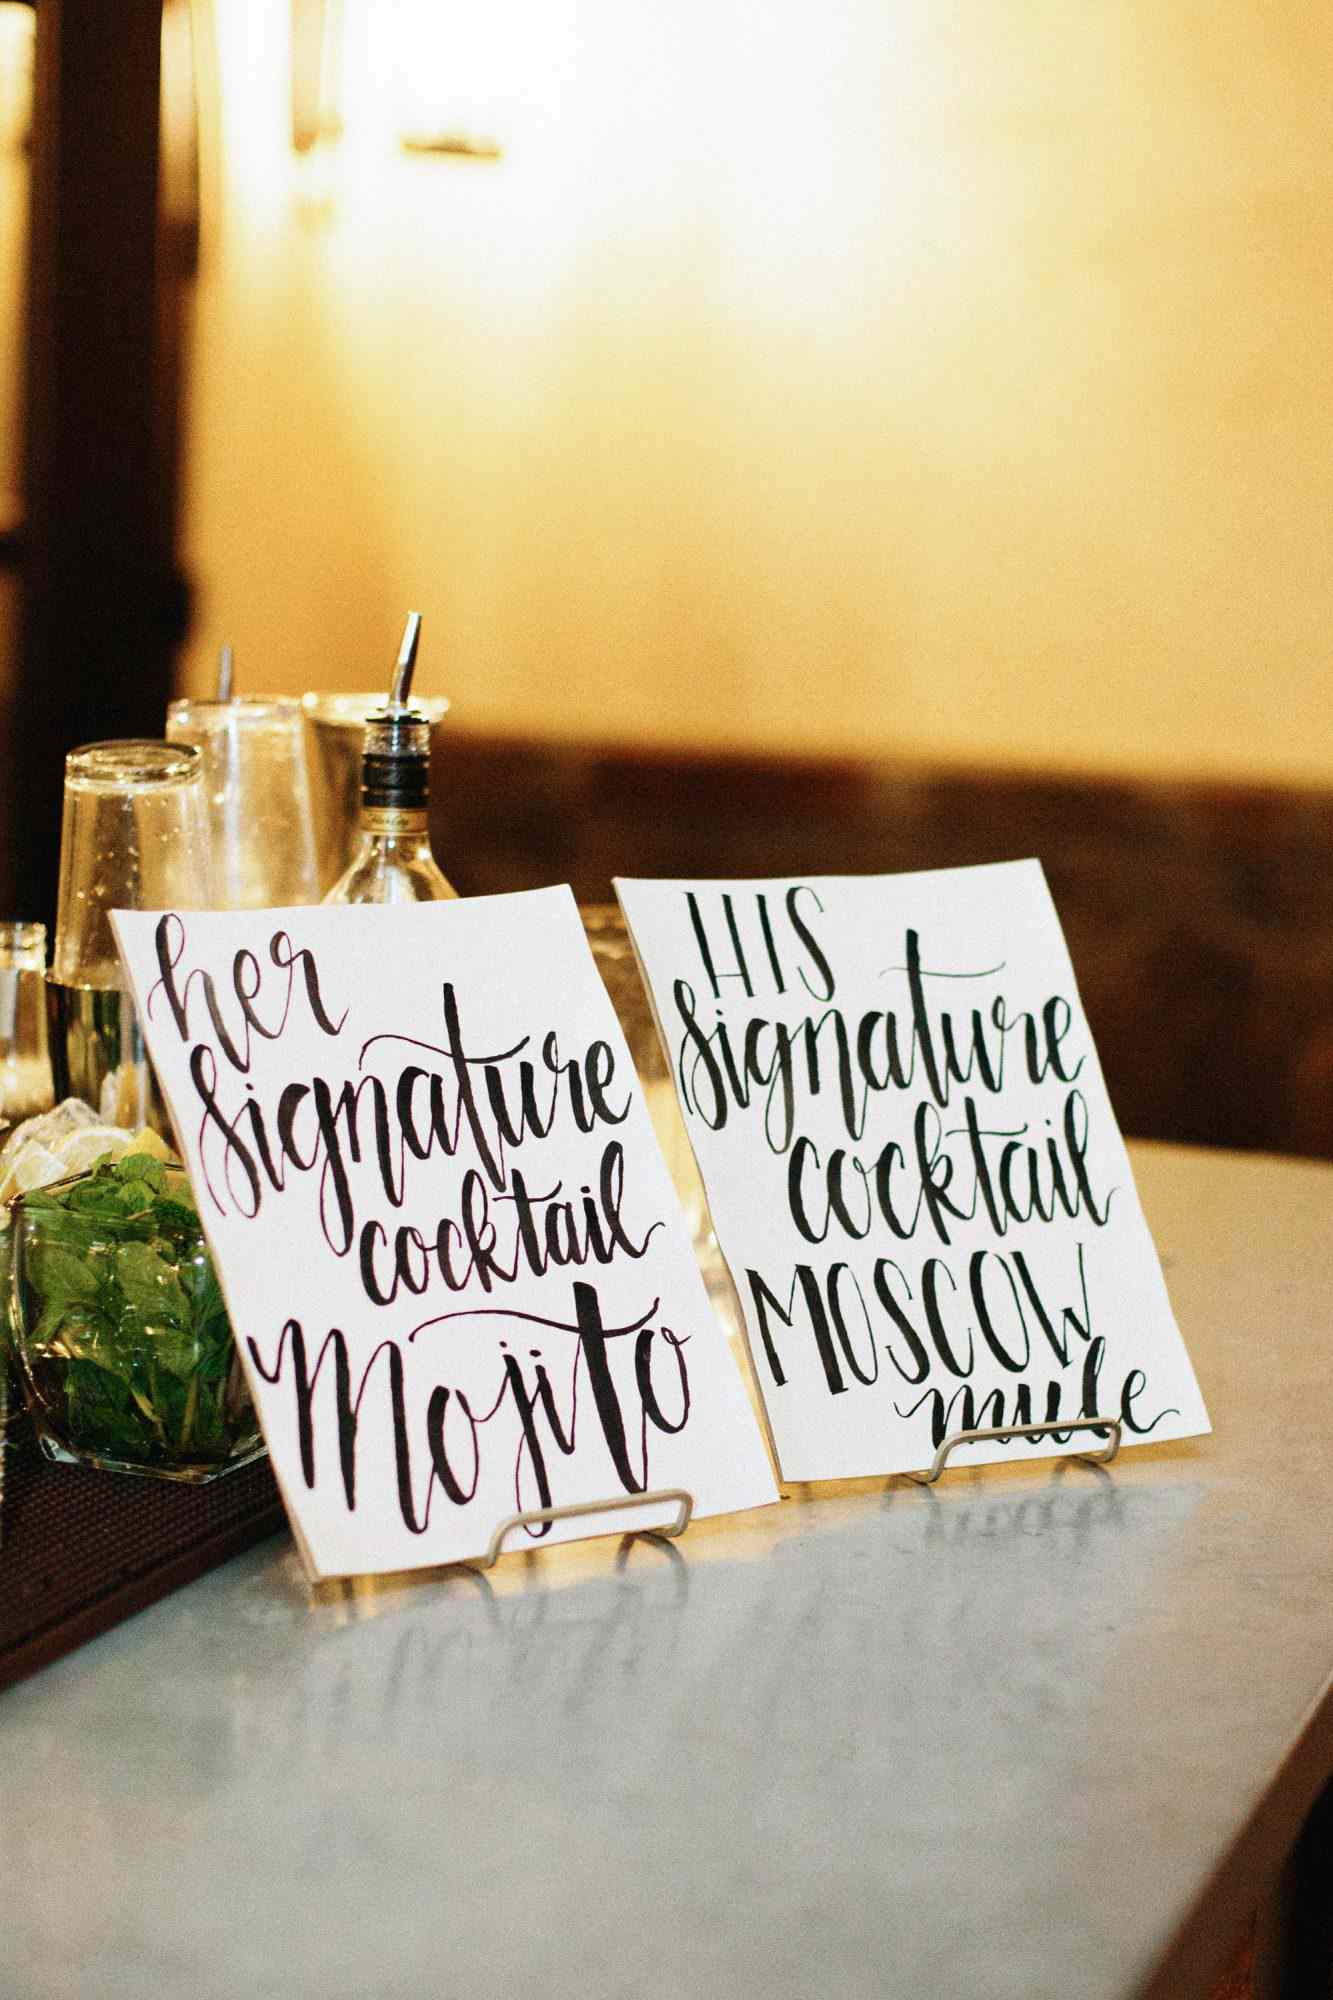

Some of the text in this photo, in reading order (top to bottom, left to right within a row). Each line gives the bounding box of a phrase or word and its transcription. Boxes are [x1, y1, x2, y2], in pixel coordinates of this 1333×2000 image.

[148, 912, 349, 1072] her
[684, 886, 835, 1001] HIS
[360, 1141, 665, 1306] cocktail
[788, 1090, 1118, 1244] cocktail
[745, 1243, 1091, 1395] MOSCOW
[894, 1336, 1180, 1450] mule
[247, 1281, 691, 1537] Mojito
